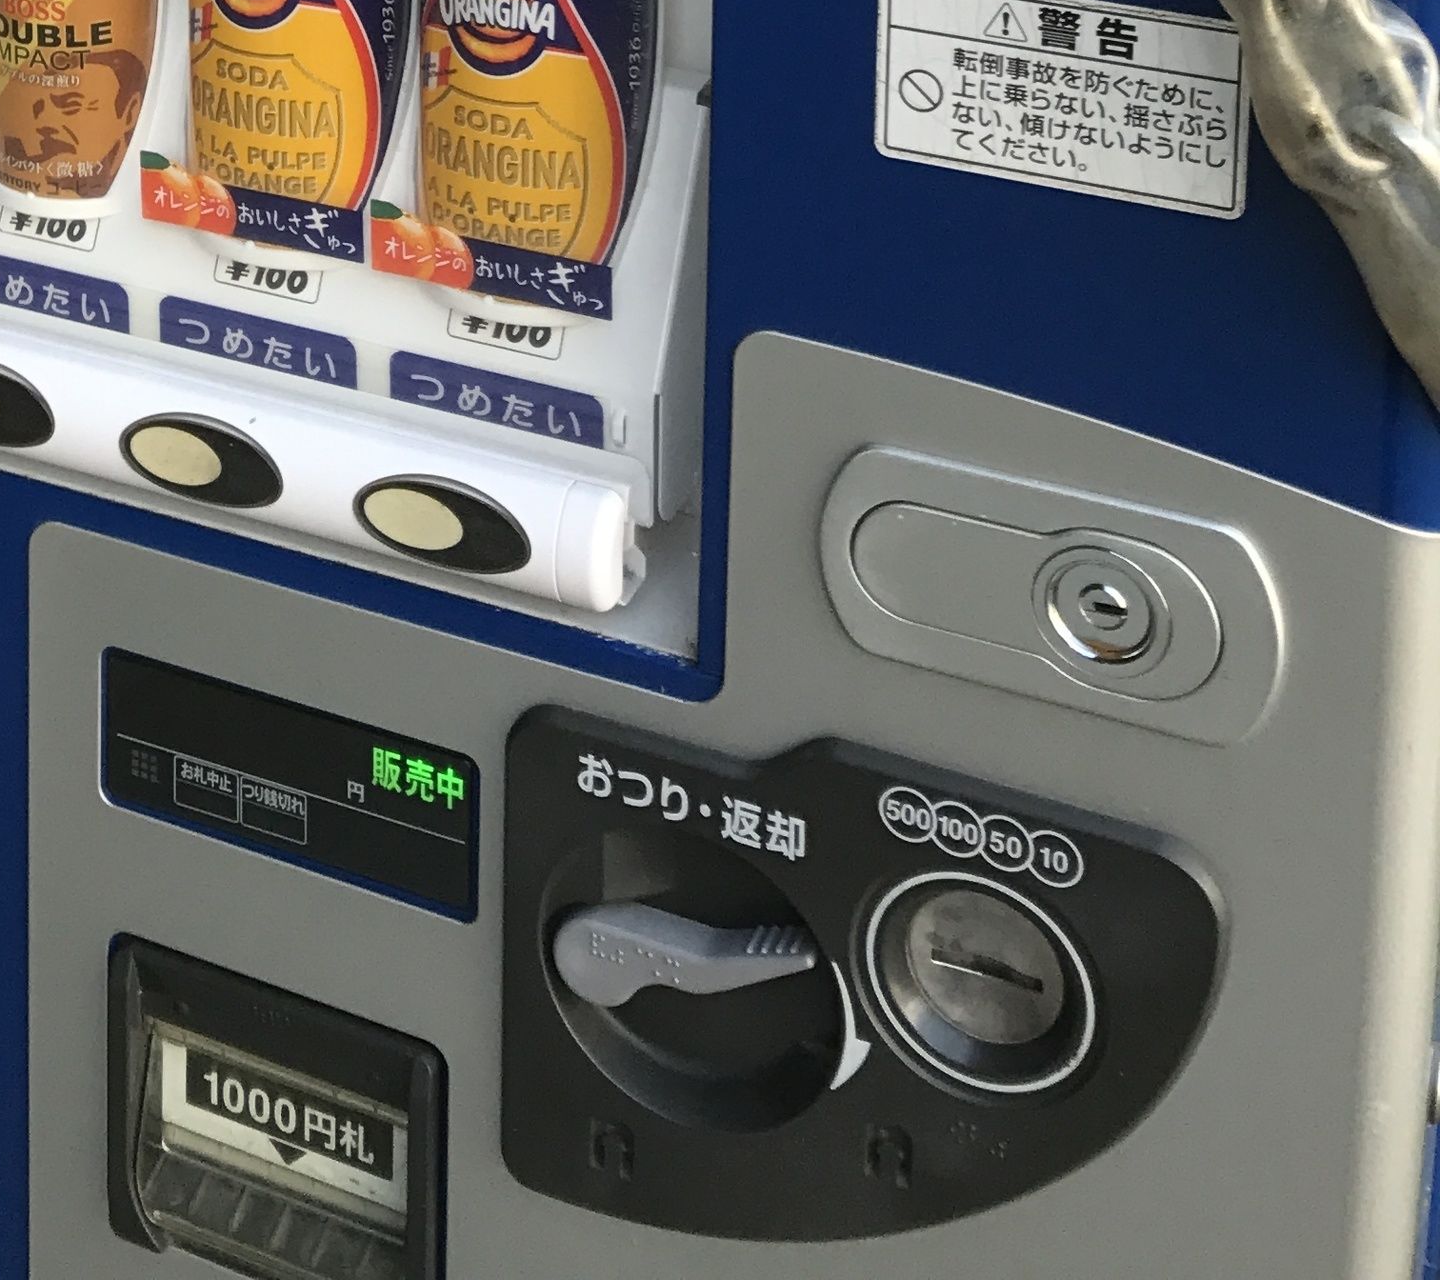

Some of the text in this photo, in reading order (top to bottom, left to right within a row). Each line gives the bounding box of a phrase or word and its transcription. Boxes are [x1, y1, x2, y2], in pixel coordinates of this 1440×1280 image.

[1038, 7, 1139, 59] 警告
[217, 59, 287, 91] SODA
[953, 48, 1224, 113] 転倒事故を防ぐために、
[952, 76, 1227, 141] 上に乗らない、揺さぶら
[952, 103, 1226, 168] ない、傾けないようにし
[951, 129, 1087, 171] てください。
[153, 187, 230, 219] オレンジの
[411, 375, 581, 435] つめたい
[181, 762, 232, 792] お札中止
[243, 783, 305, 814] つり銭切れ
[348, 779, 364, 803] 円
[372, 747, 464, 809] 販売中
[576, 753, 806, 860] おつり・返却
[886, 797, 1069, 870] 500 100 50 10
[204, 1071, 373, 1163] 1000円札
